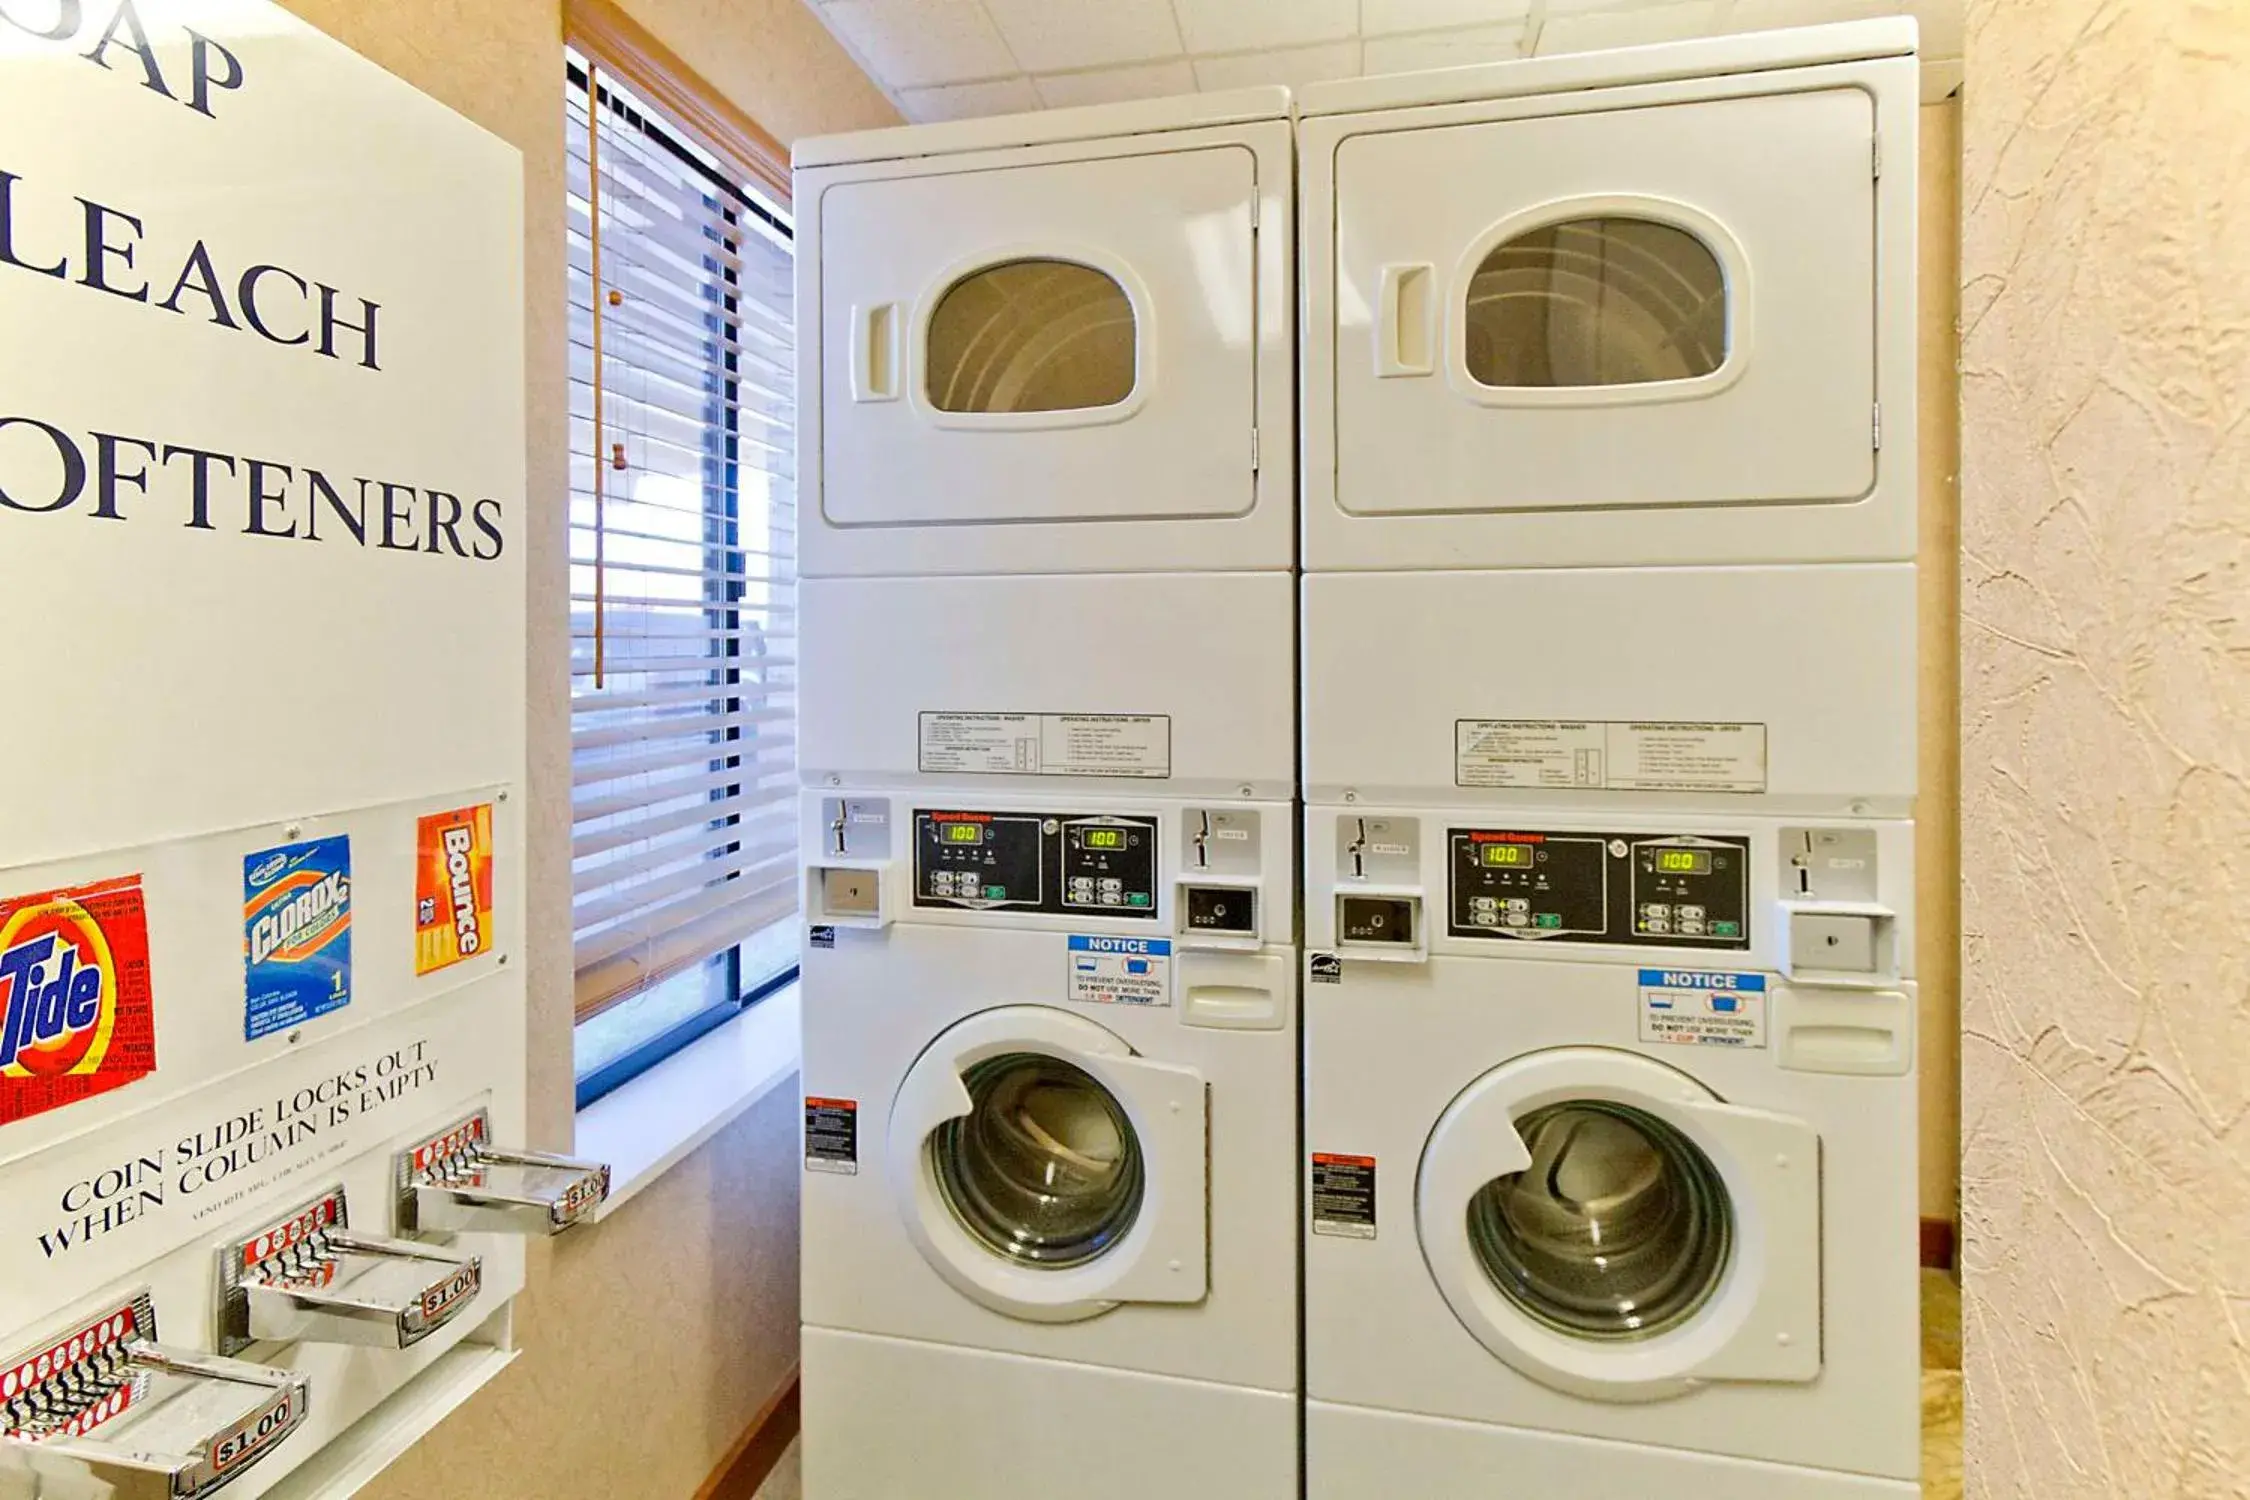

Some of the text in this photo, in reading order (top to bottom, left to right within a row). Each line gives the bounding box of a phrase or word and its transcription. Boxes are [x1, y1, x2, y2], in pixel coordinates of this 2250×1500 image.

[0, 170, 382, 371] LEACH
[0, 417, 503, 561] OFTENERS
[951, 826, 976, 841] 100
[1091, 831, 1117, 846] 100
[1489, 846, 1518, 862] 100
[1663, 852, 1694, 870] 100
[442, 826, 480, 955] Bounce
[1088, 938, 1149, 953] NOTICE
[0, 932, 101, 1067] Tide
[1663, 972, 1738, 989] NOTICE
[62, 1040, 429, 1214] COIN SLIDE LOCKS OUT
[37, 1060, 439, 1260] WHEN COLUMN IS EMPTY
[427, 1269, 473, 1312] $1.00
[219, 1403, 287, 1462] $1.00
